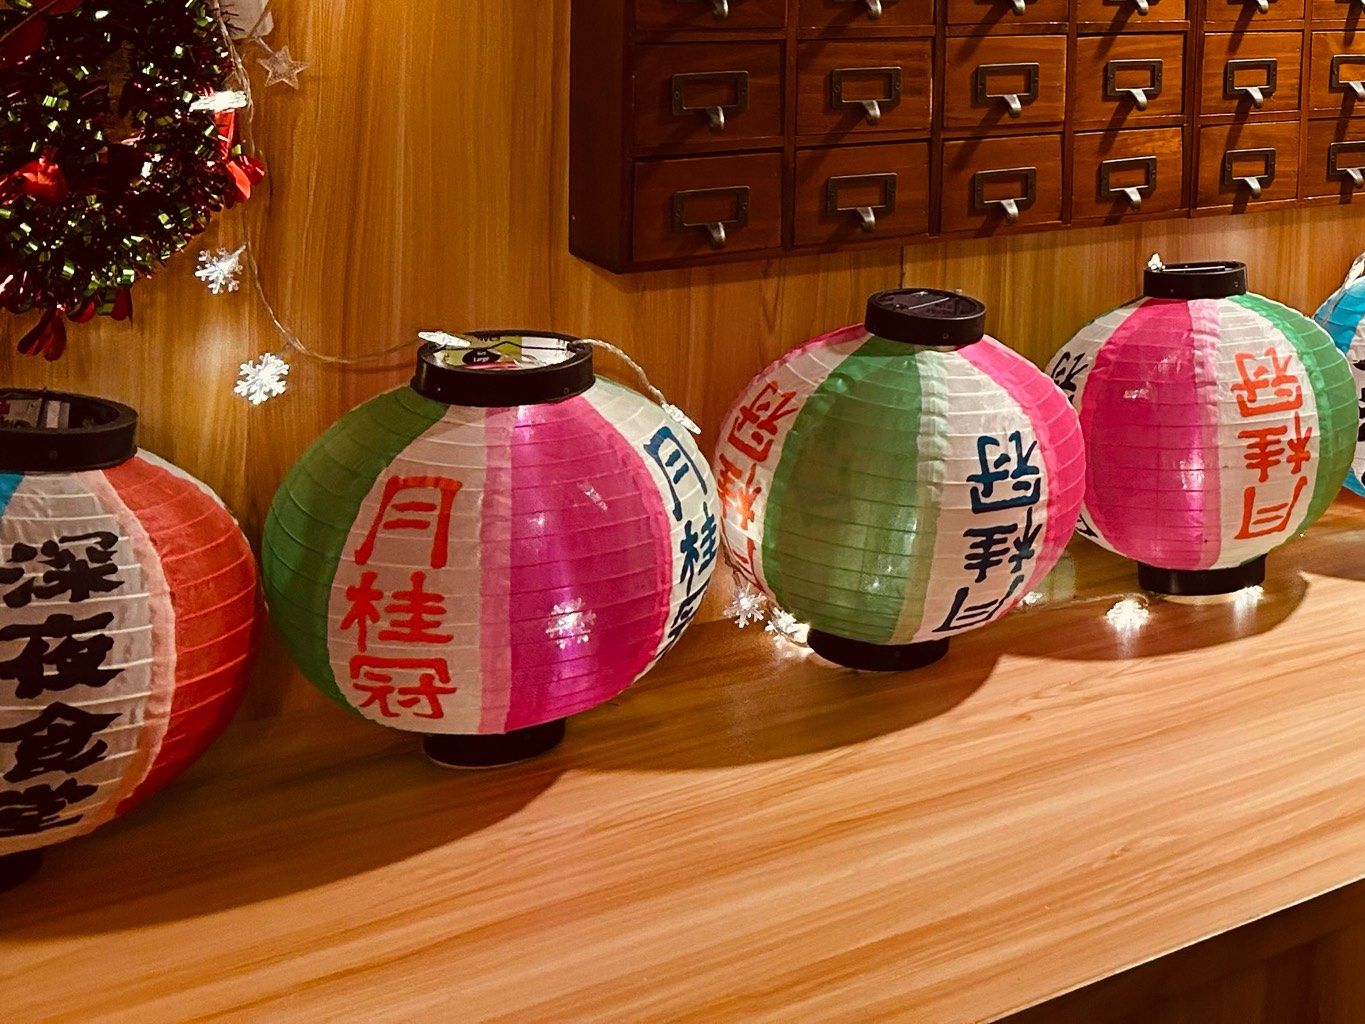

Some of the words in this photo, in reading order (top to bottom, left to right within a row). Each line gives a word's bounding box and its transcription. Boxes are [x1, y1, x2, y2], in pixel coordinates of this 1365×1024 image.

[931, 429, 1044, 633] 月桂冠
[1229, 345, 1314, 540] 月桂冠
[0, 531, 125, 835] 深夜食堂
[339, 475, 463, 720] 月桂冠
